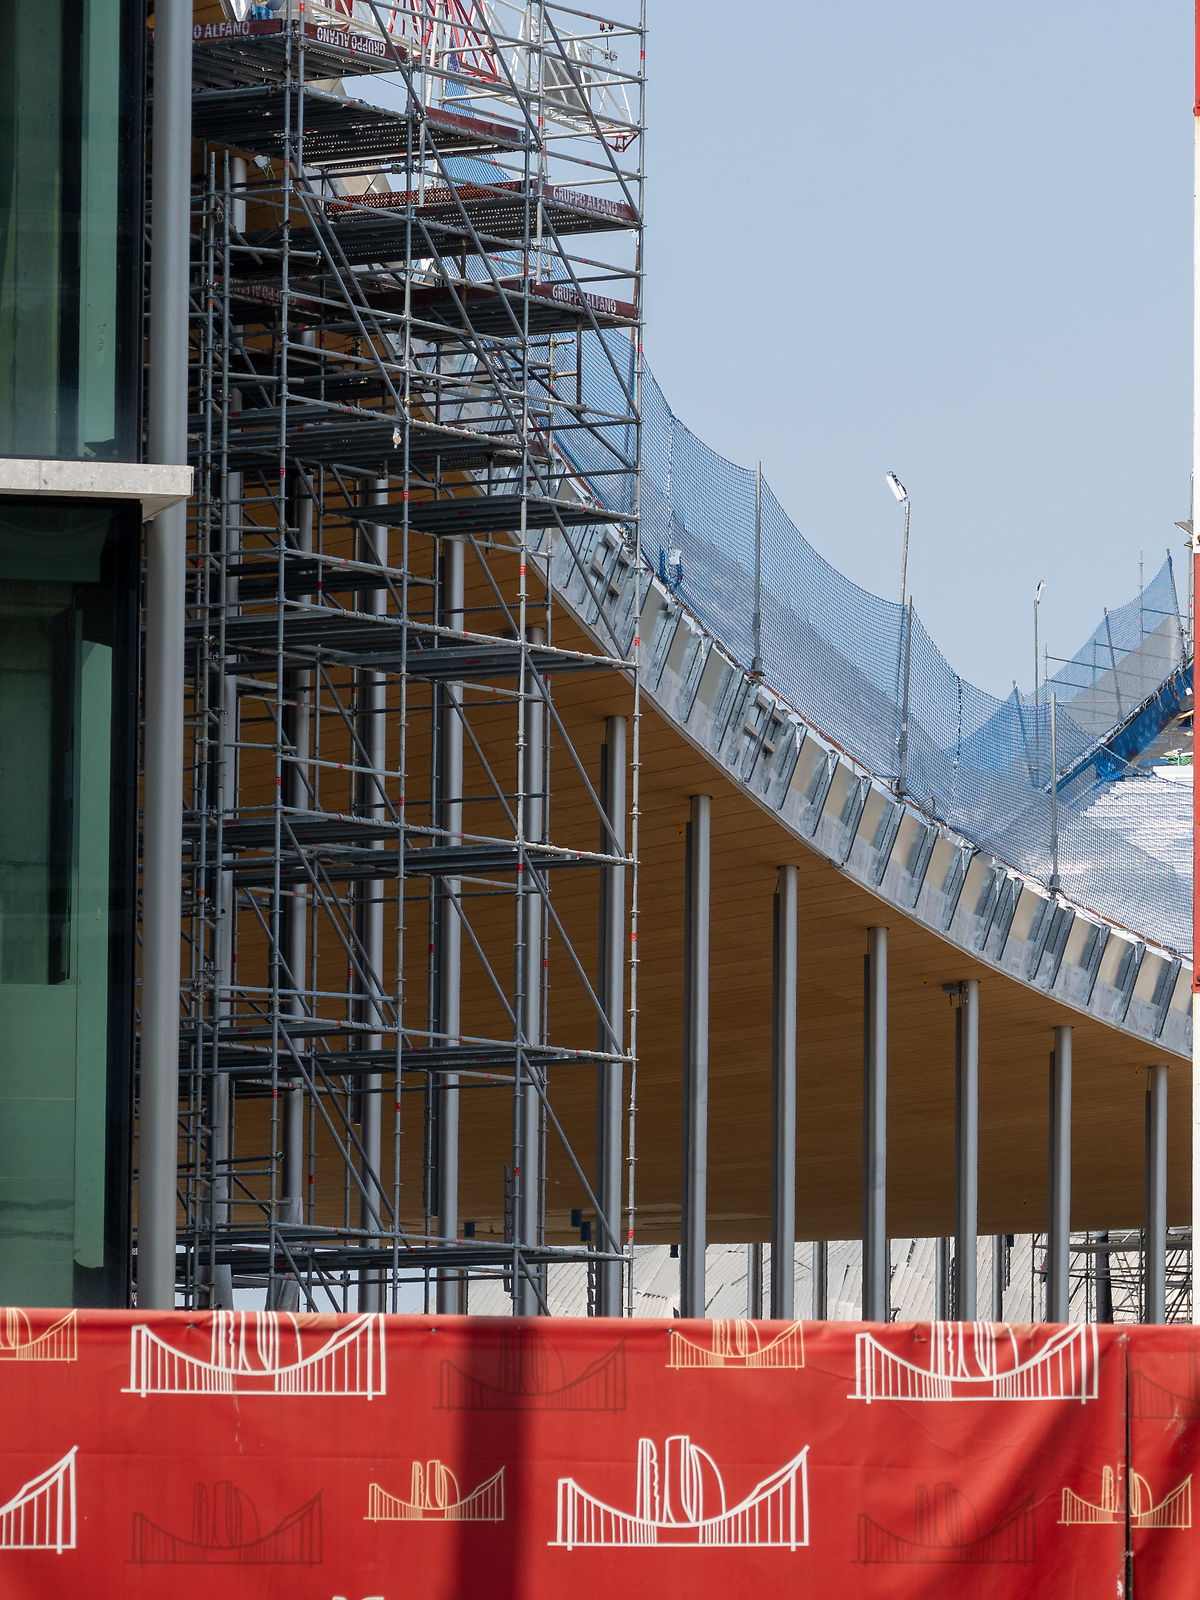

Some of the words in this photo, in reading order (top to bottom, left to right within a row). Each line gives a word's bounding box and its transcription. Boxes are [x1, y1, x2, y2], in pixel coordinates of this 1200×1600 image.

[204, 20, 250, 39] ALFANO
[316, 26, 350, 48] ALFANO
[351, 35, 386, 57] GRUPPO
[553, 186, 586, 206] GRUPPO
[587, 194, 618, 215] ALFANO
[552, 284, 583, 306] GRUPP
[586, 293, 617, 313] ALFANO
